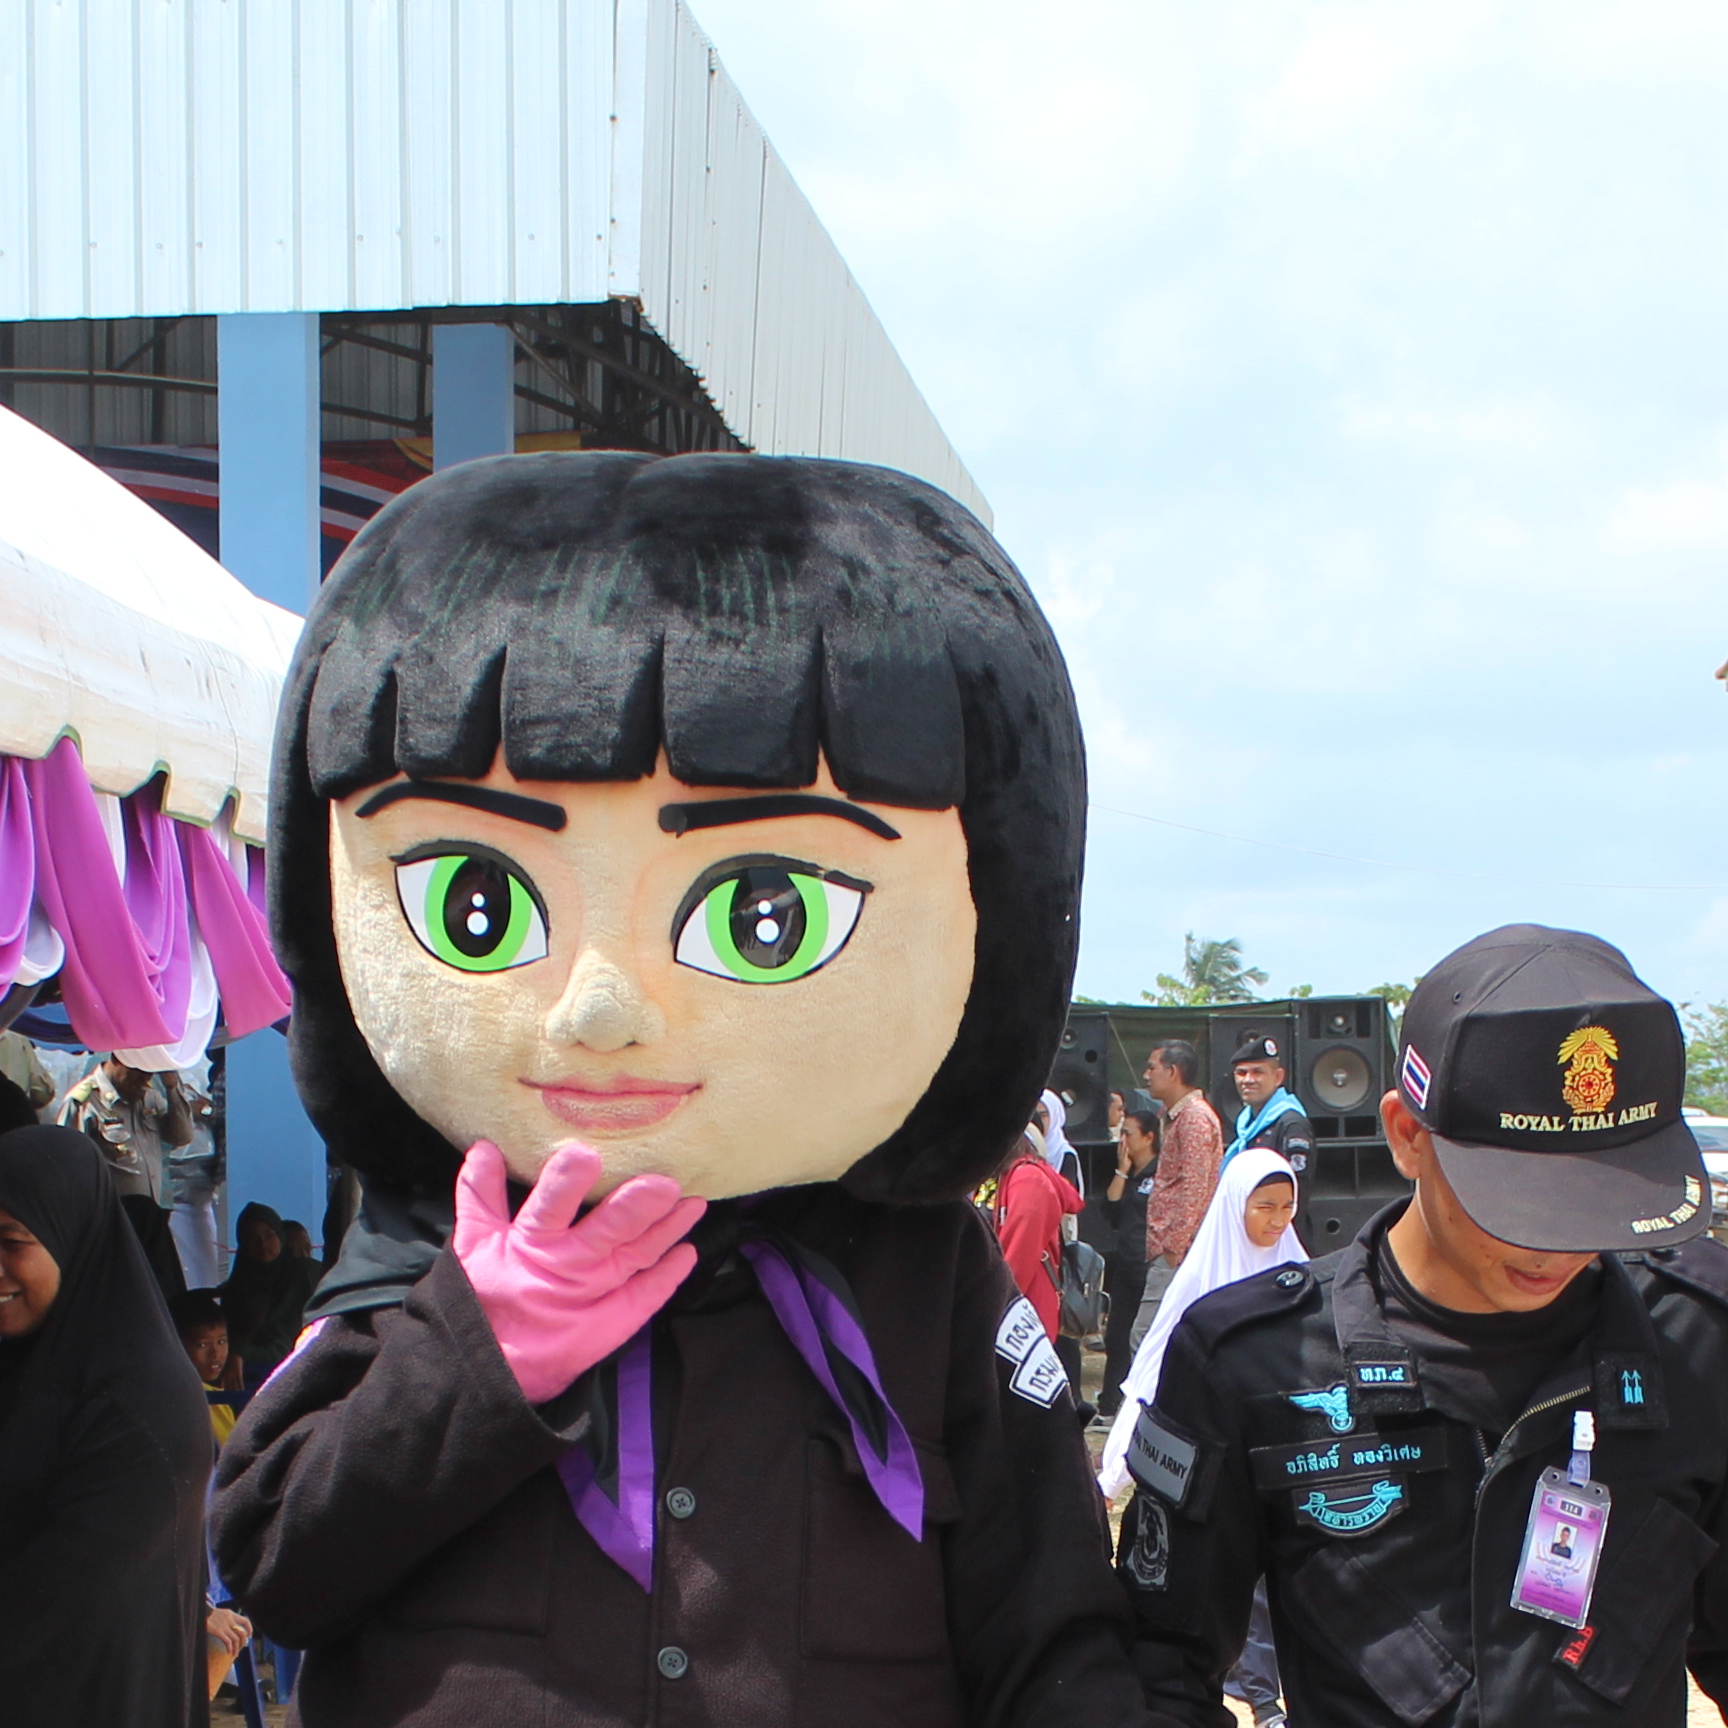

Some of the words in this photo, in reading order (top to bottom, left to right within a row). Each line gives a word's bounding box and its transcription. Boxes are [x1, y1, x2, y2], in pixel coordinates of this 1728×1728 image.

[1499, 1113, 1565, 1132] ROYAL
[1568, 1112, 1614, 1132] THAI
[1618, 1102, 1657, 1126] ARMY
[1631, 1216, 1676, 1235] ROYAL
[1668, 1202, 1697, 1225] THAI
[1684, 1174, 1701, 1207] ARMY
[1160, 1454, 1188, 1480] ARMY
